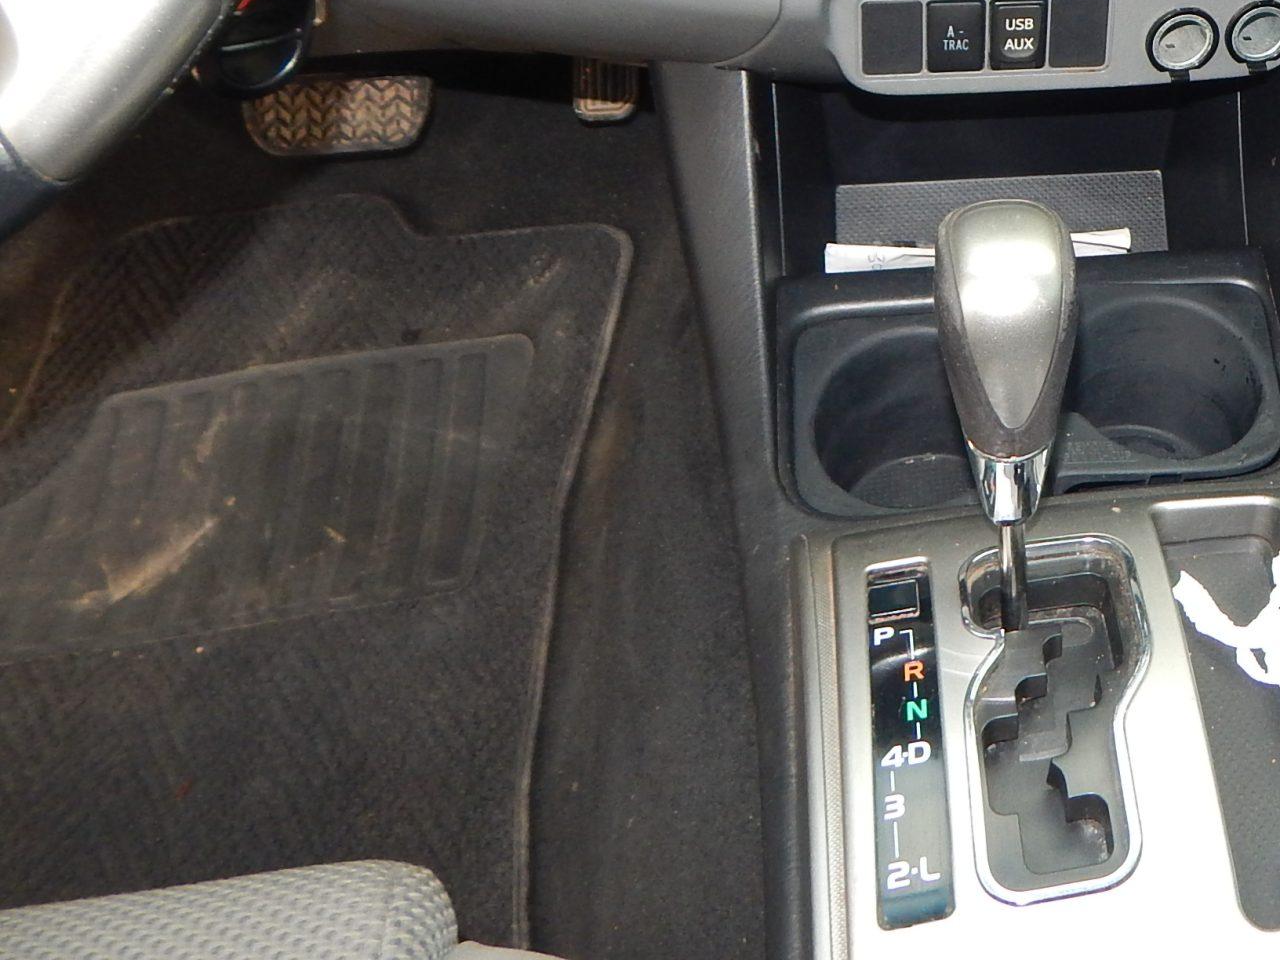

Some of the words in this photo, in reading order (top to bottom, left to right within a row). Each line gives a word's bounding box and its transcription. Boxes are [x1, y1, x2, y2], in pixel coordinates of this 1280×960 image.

[1005, 18, 1034, 31] USB
[943, 39, 969, 51] TRAC
[1004, 38, 1034, 51] AUX
[873, 627, 895, 646] P
[904, 660, 925, 682] R
[906, 699, 928, 721] N
[884, 793, 906, 821] 3
